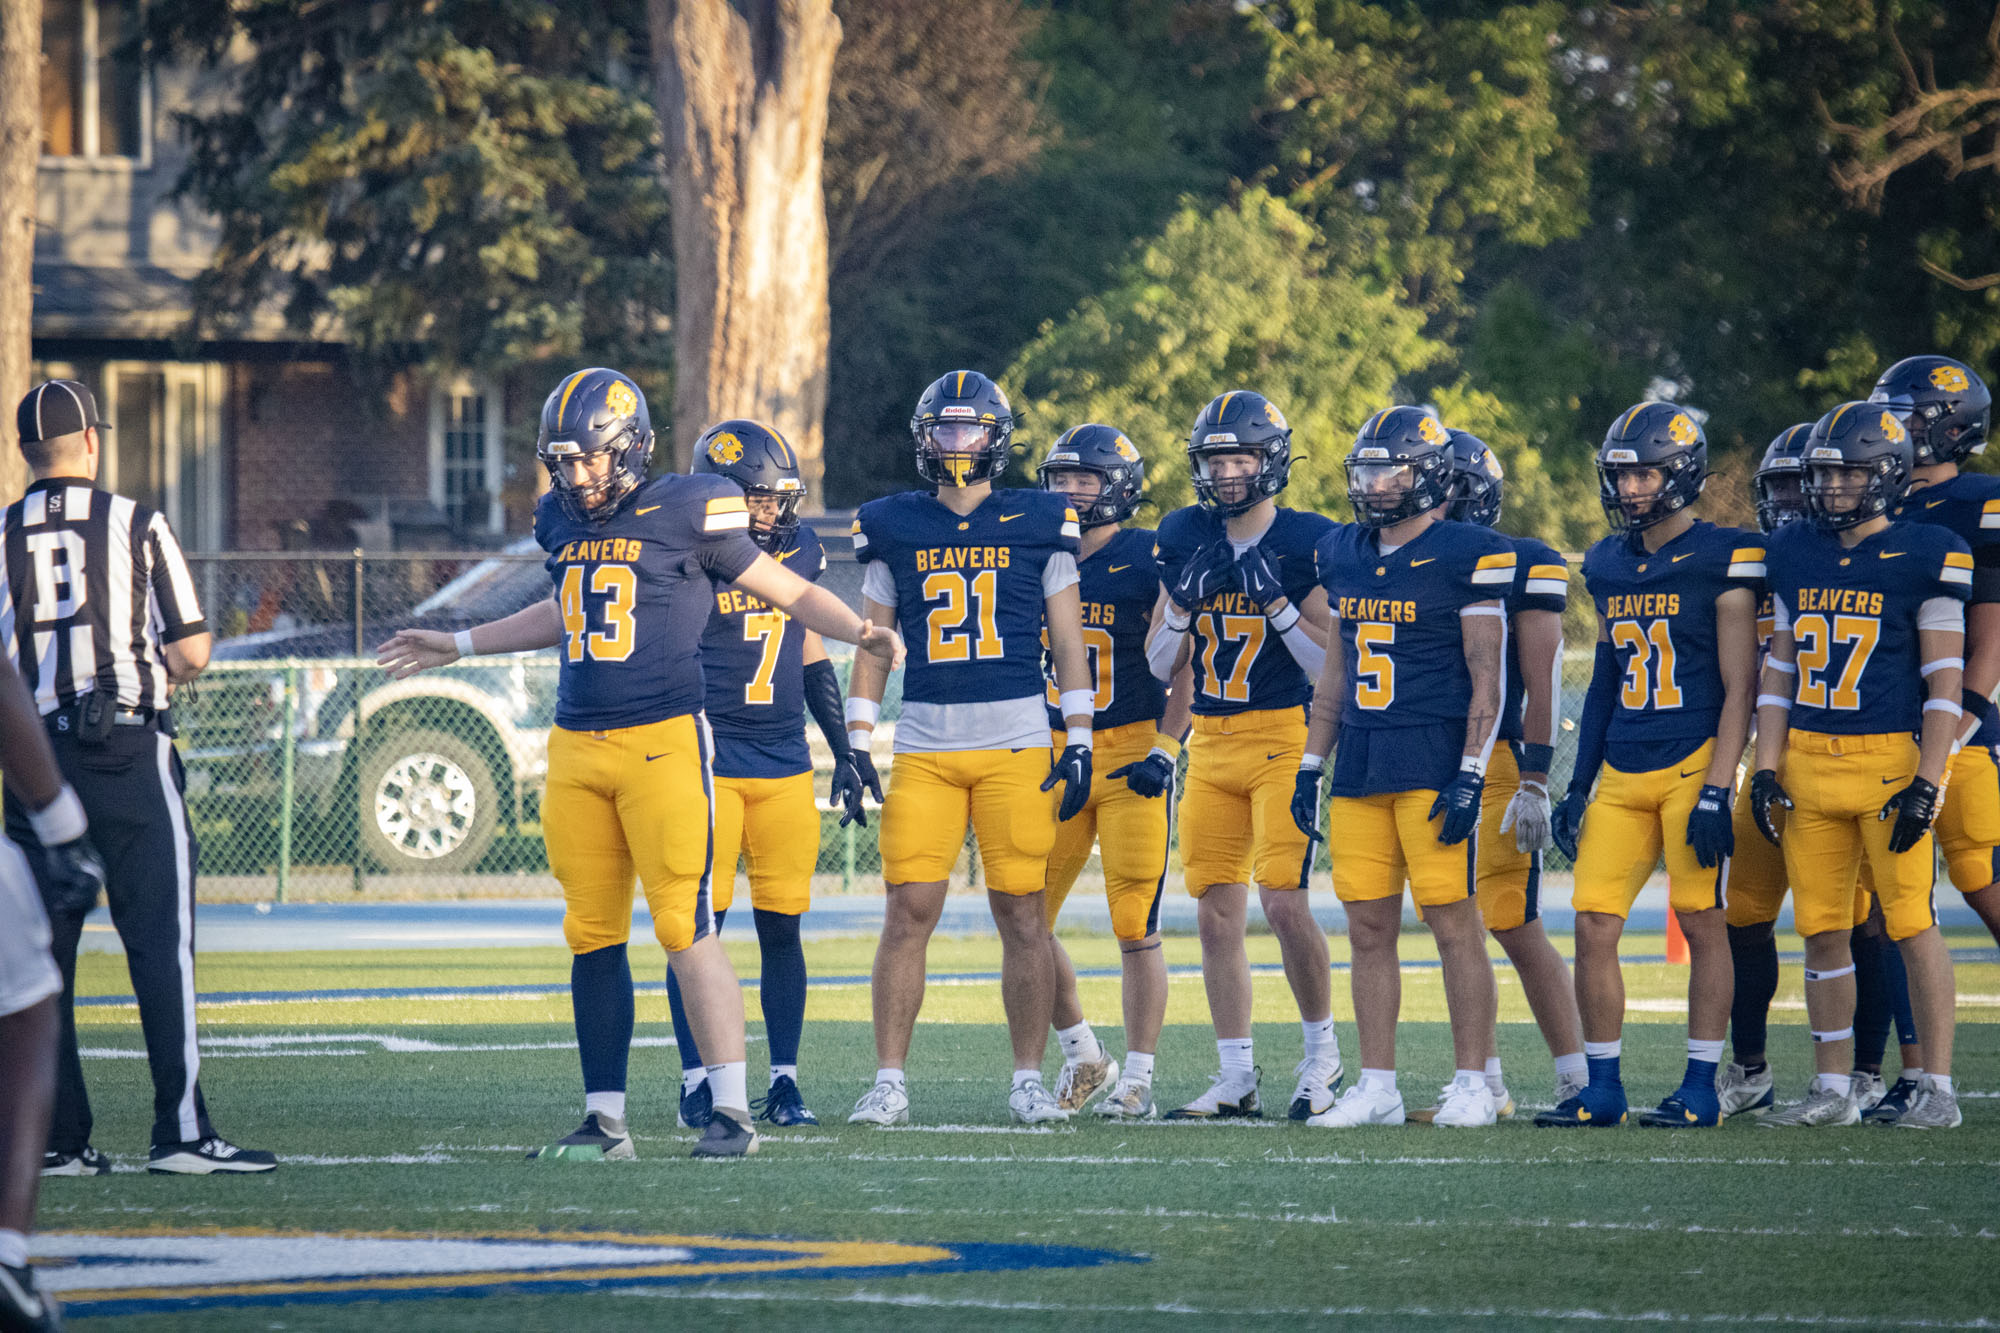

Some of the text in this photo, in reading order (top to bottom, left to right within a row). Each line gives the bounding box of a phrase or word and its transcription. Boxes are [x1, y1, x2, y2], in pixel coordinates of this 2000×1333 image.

[26, 529, 88, 623] B
[915, 546, 1010, 572] BEAVERS
[1798, 588, 1884, 615] BEAVERS
[559, 563, 637, 663] 43
[922, 569, 1004, 664] 21
[1339, 596, 1416, 623] BEAVERS
[1607, 593, 1680, 619] BEAVERS
[744, 611, 786, 705] 7
[1195, 612, 1267, 703] 17
[1354, 621, 1395, 711] 5
[1610, 618, 1683, 710] 31
[1793, 613, 1882, 711] 27
